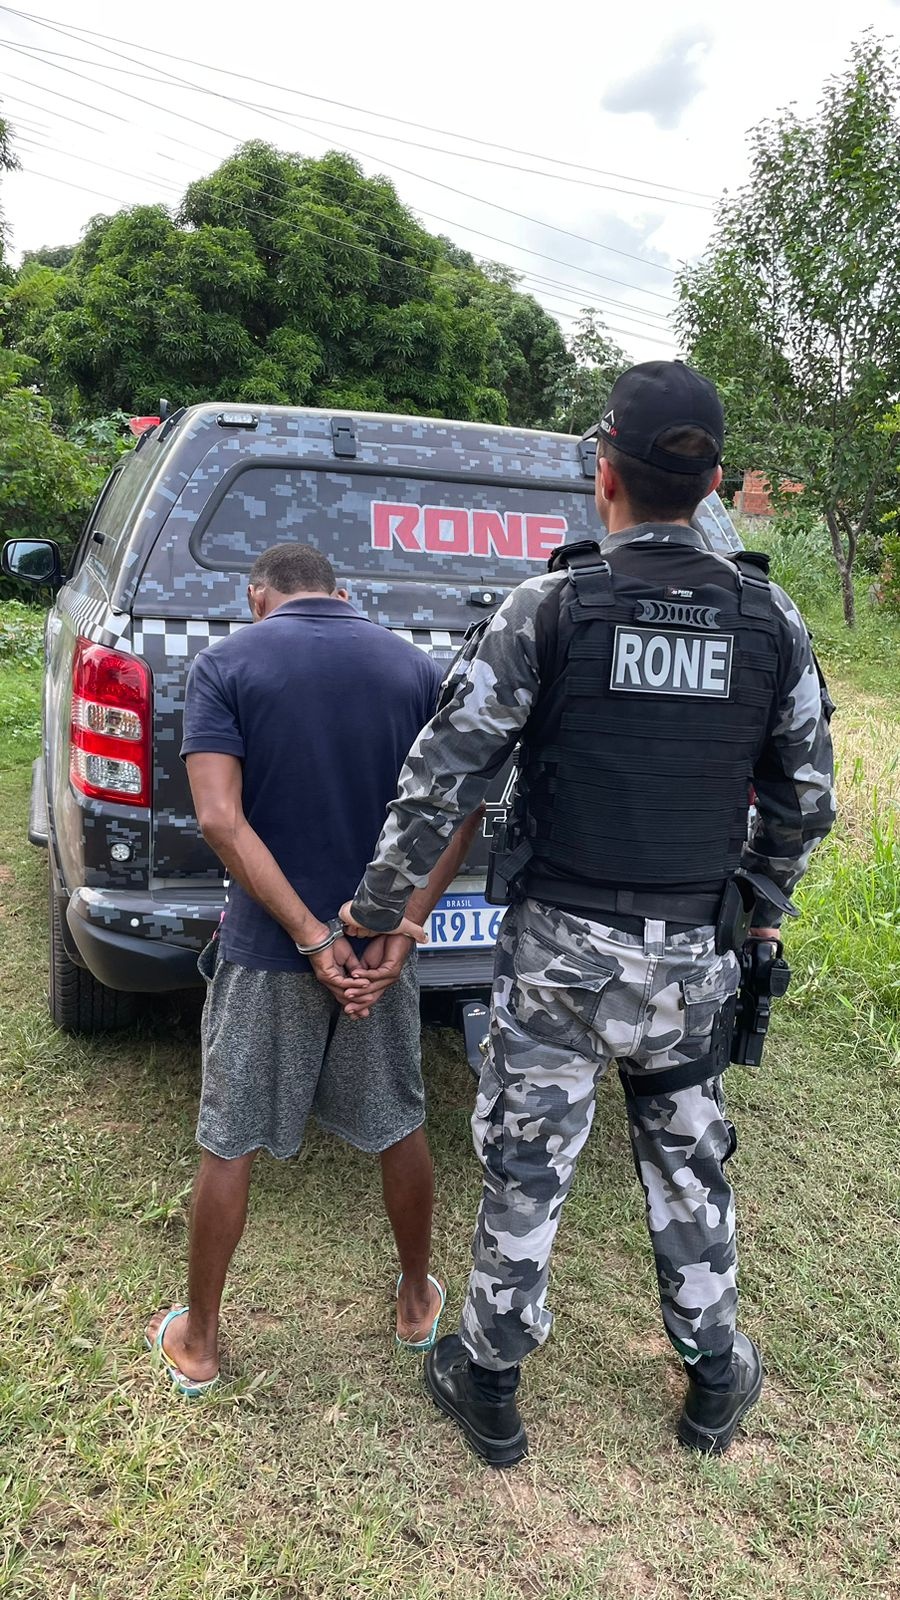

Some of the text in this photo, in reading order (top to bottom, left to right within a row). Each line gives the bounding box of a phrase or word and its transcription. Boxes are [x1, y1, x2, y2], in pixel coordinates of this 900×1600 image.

[371, 500, 568, 561] RONE
[615, 633, 727, 690] RONE
[424, 911, 501, 942] R9I6
